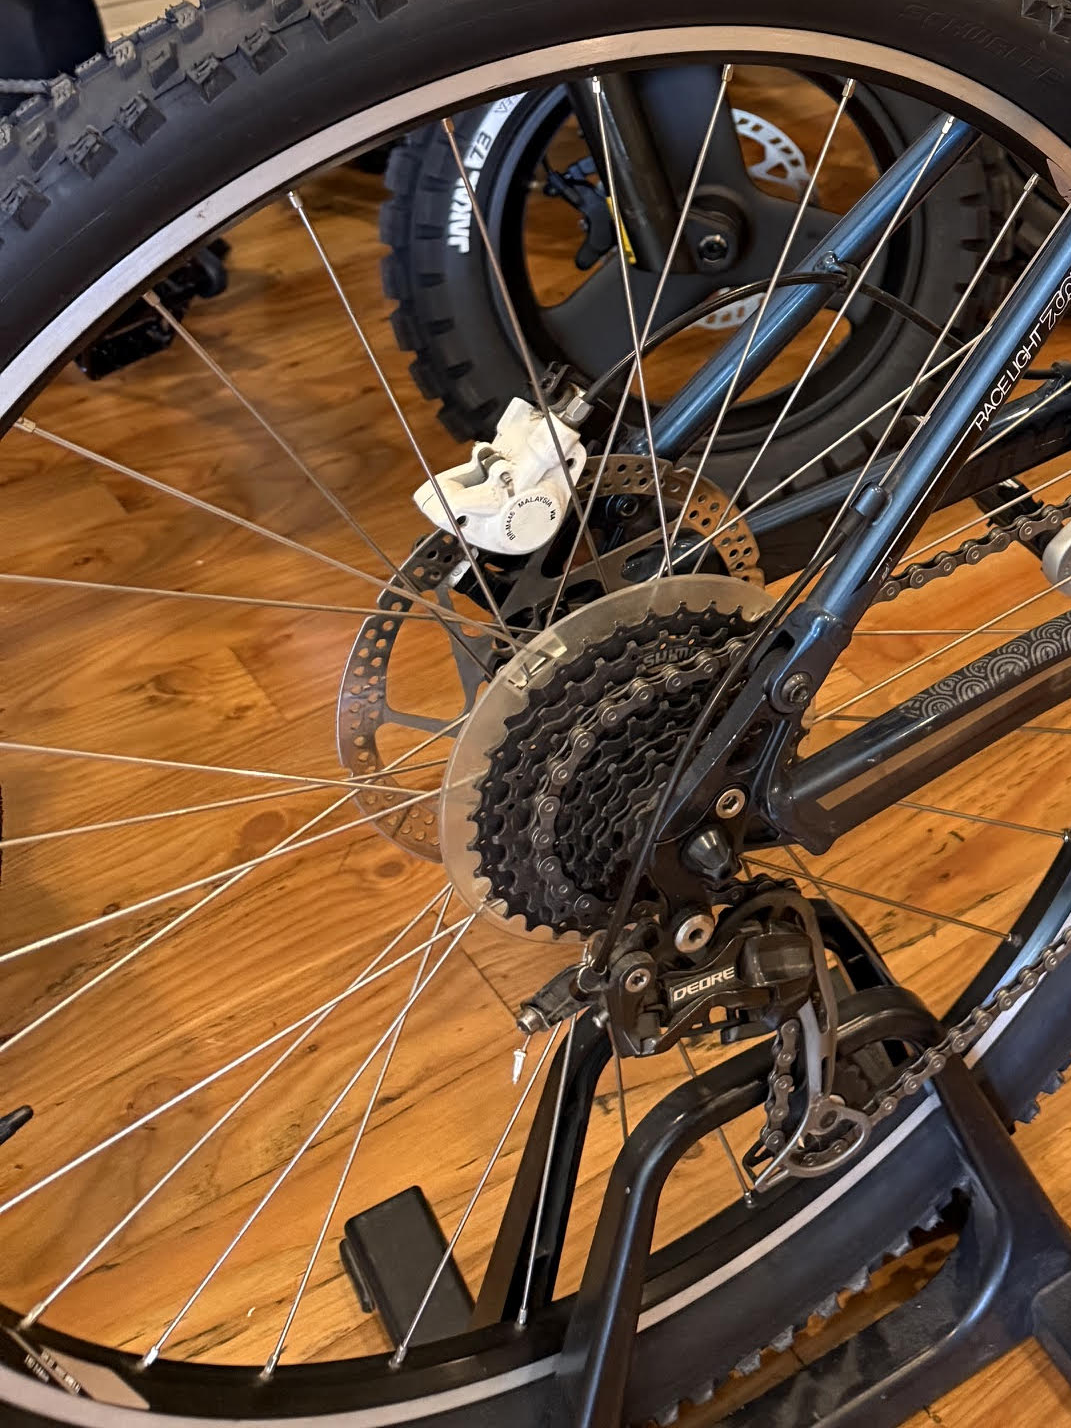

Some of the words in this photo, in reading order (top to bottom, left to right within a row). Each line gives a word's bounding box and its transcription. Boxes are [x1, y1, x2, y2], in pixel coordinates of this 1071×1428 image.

[470, 131, 492, 160] 73
[974, 375, 1012, 432] RACE
[1007, 323, 1042, 382] LIGHT
[517, 496, 553, 508] MALAYSIA
[673, 966, 735, 1002] DEORE
